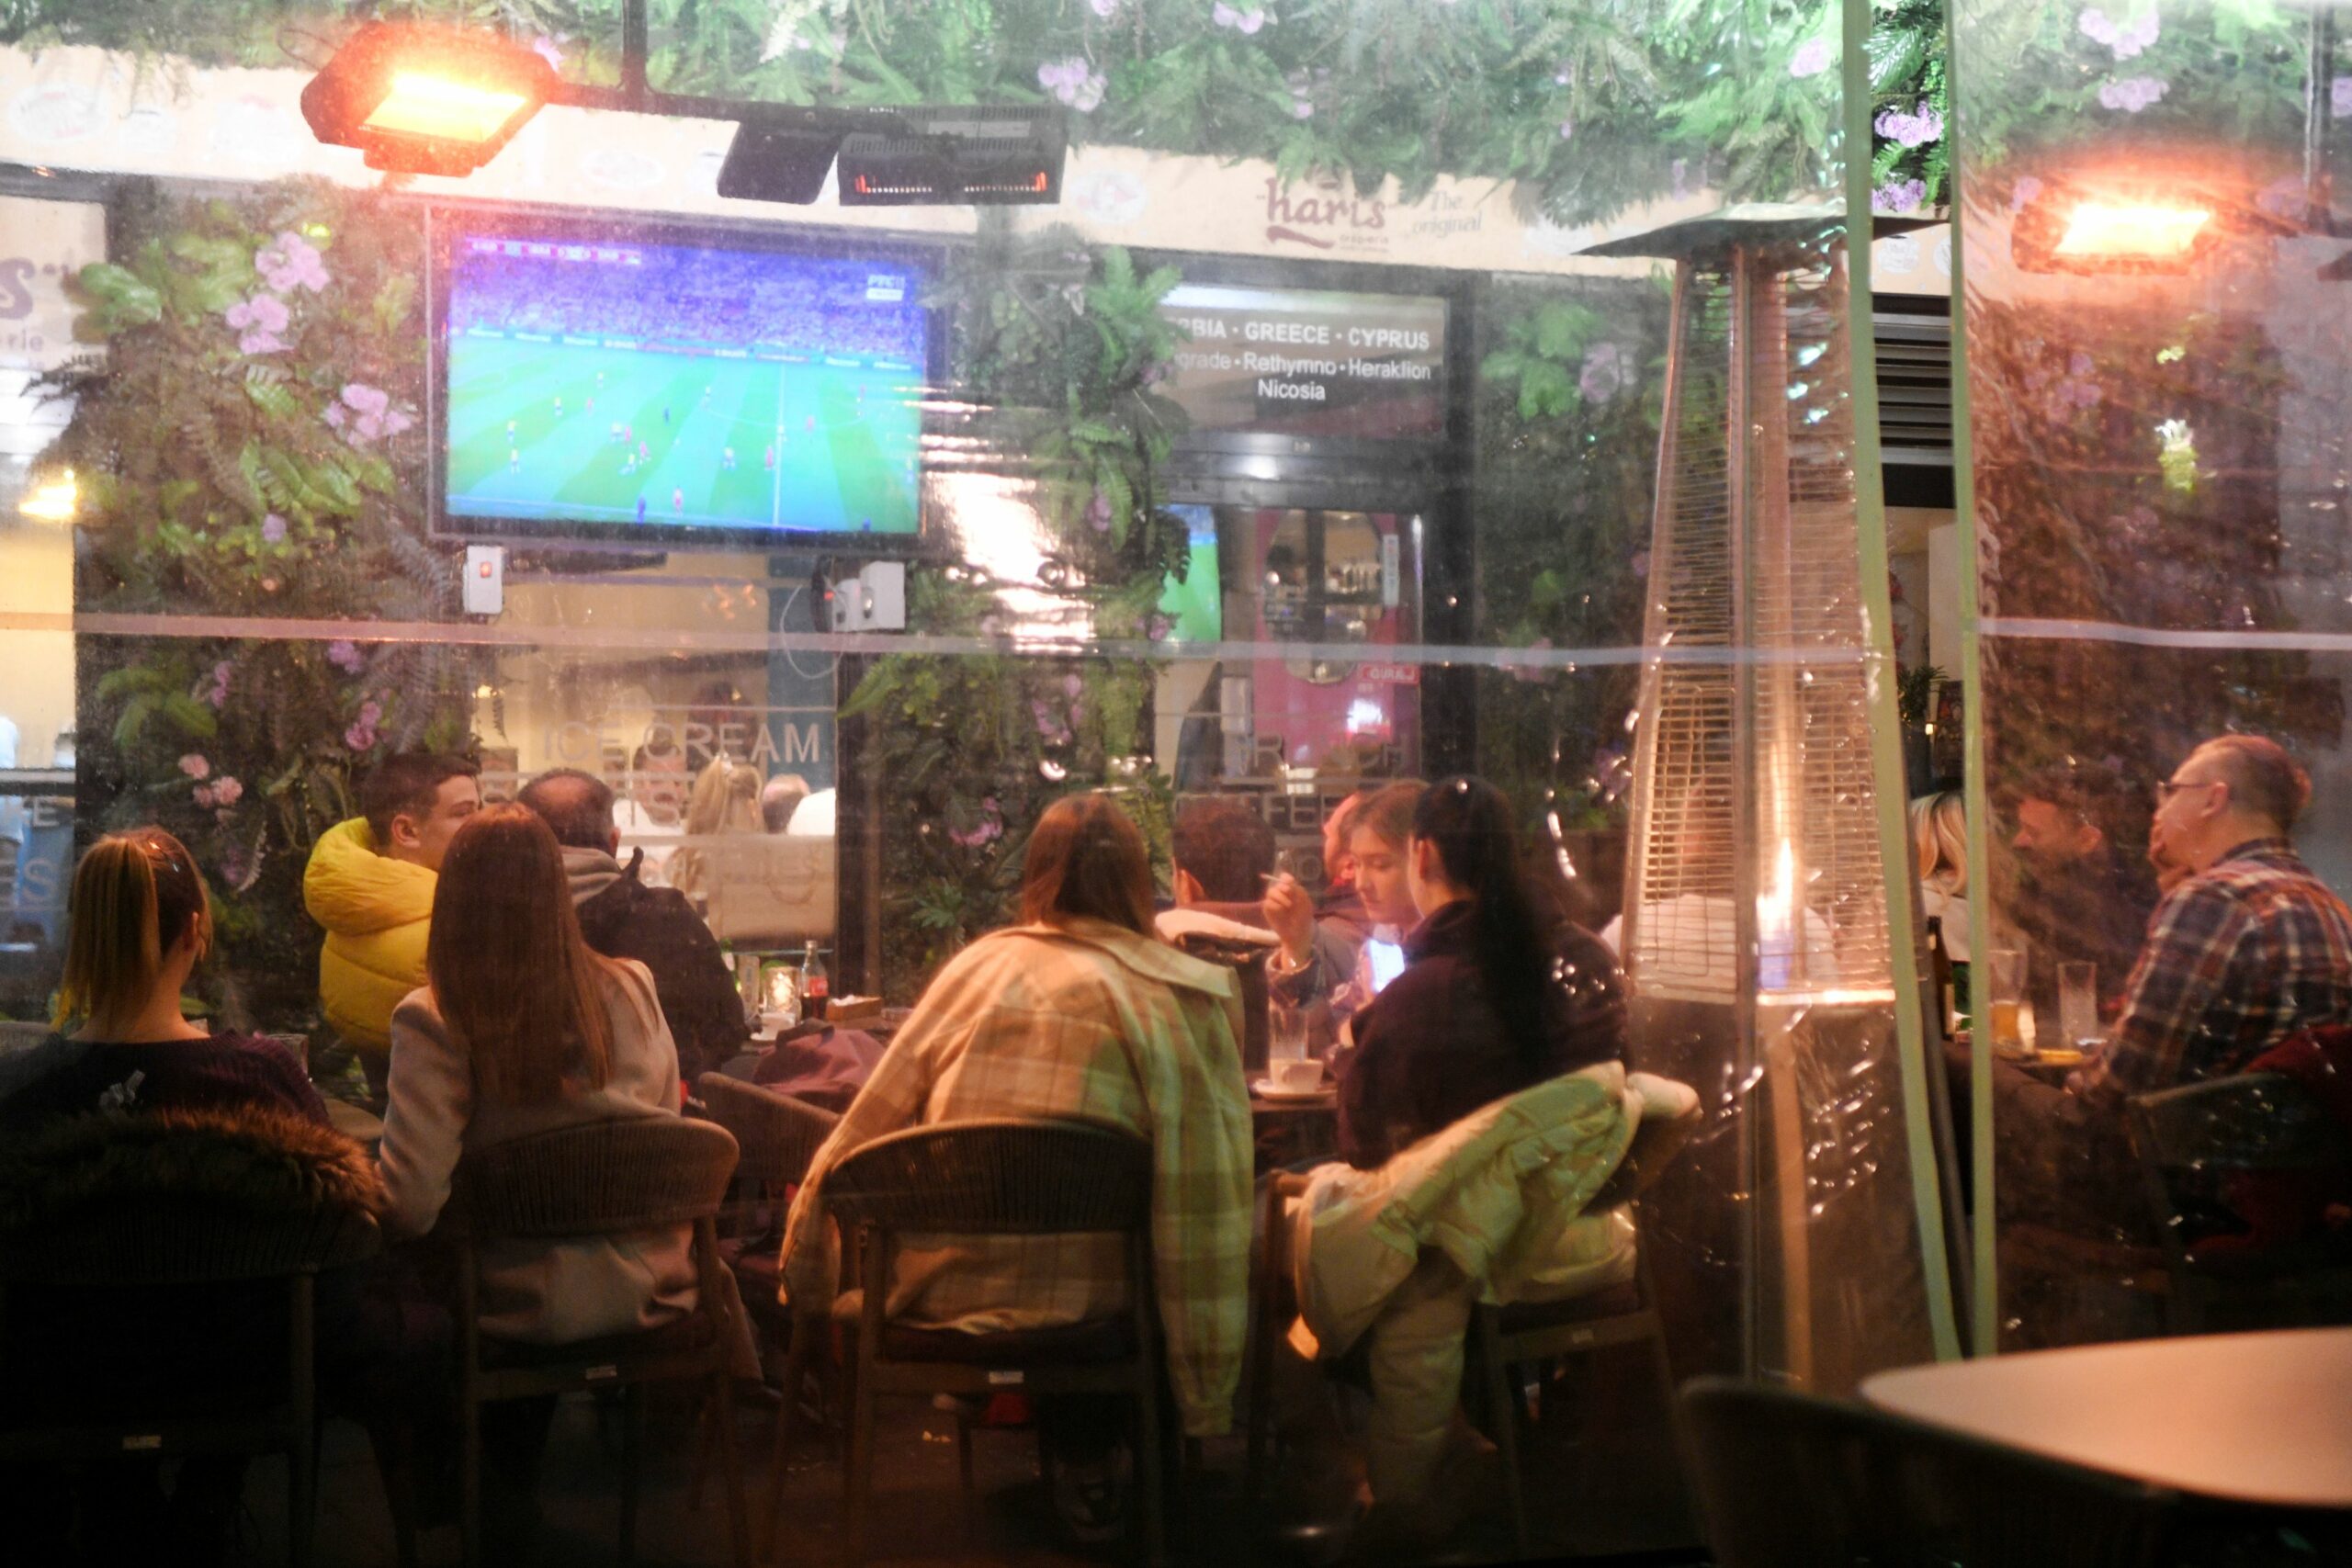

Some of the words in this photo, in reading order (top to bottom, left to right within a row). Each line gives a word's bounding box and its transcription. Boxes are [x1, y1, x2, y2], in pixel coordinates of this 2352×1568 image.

[1264, 177, 1386, 230] haris
[1431, 190, 1463, 212] The
[1412, 212, 1483, 239] original
[1245, 321, 1330, 344] GREECE
[1348, 326, 1430, 351] CYPRUS
[1244, 351, 1337, 378] Rethymno
[1348, 359, 1430, 380] Heraklion
[1258, 378, 1326, 400] Nicosia
[545, 721, 628, 761] ICE
[643, 721, 820, 764] CREAM
